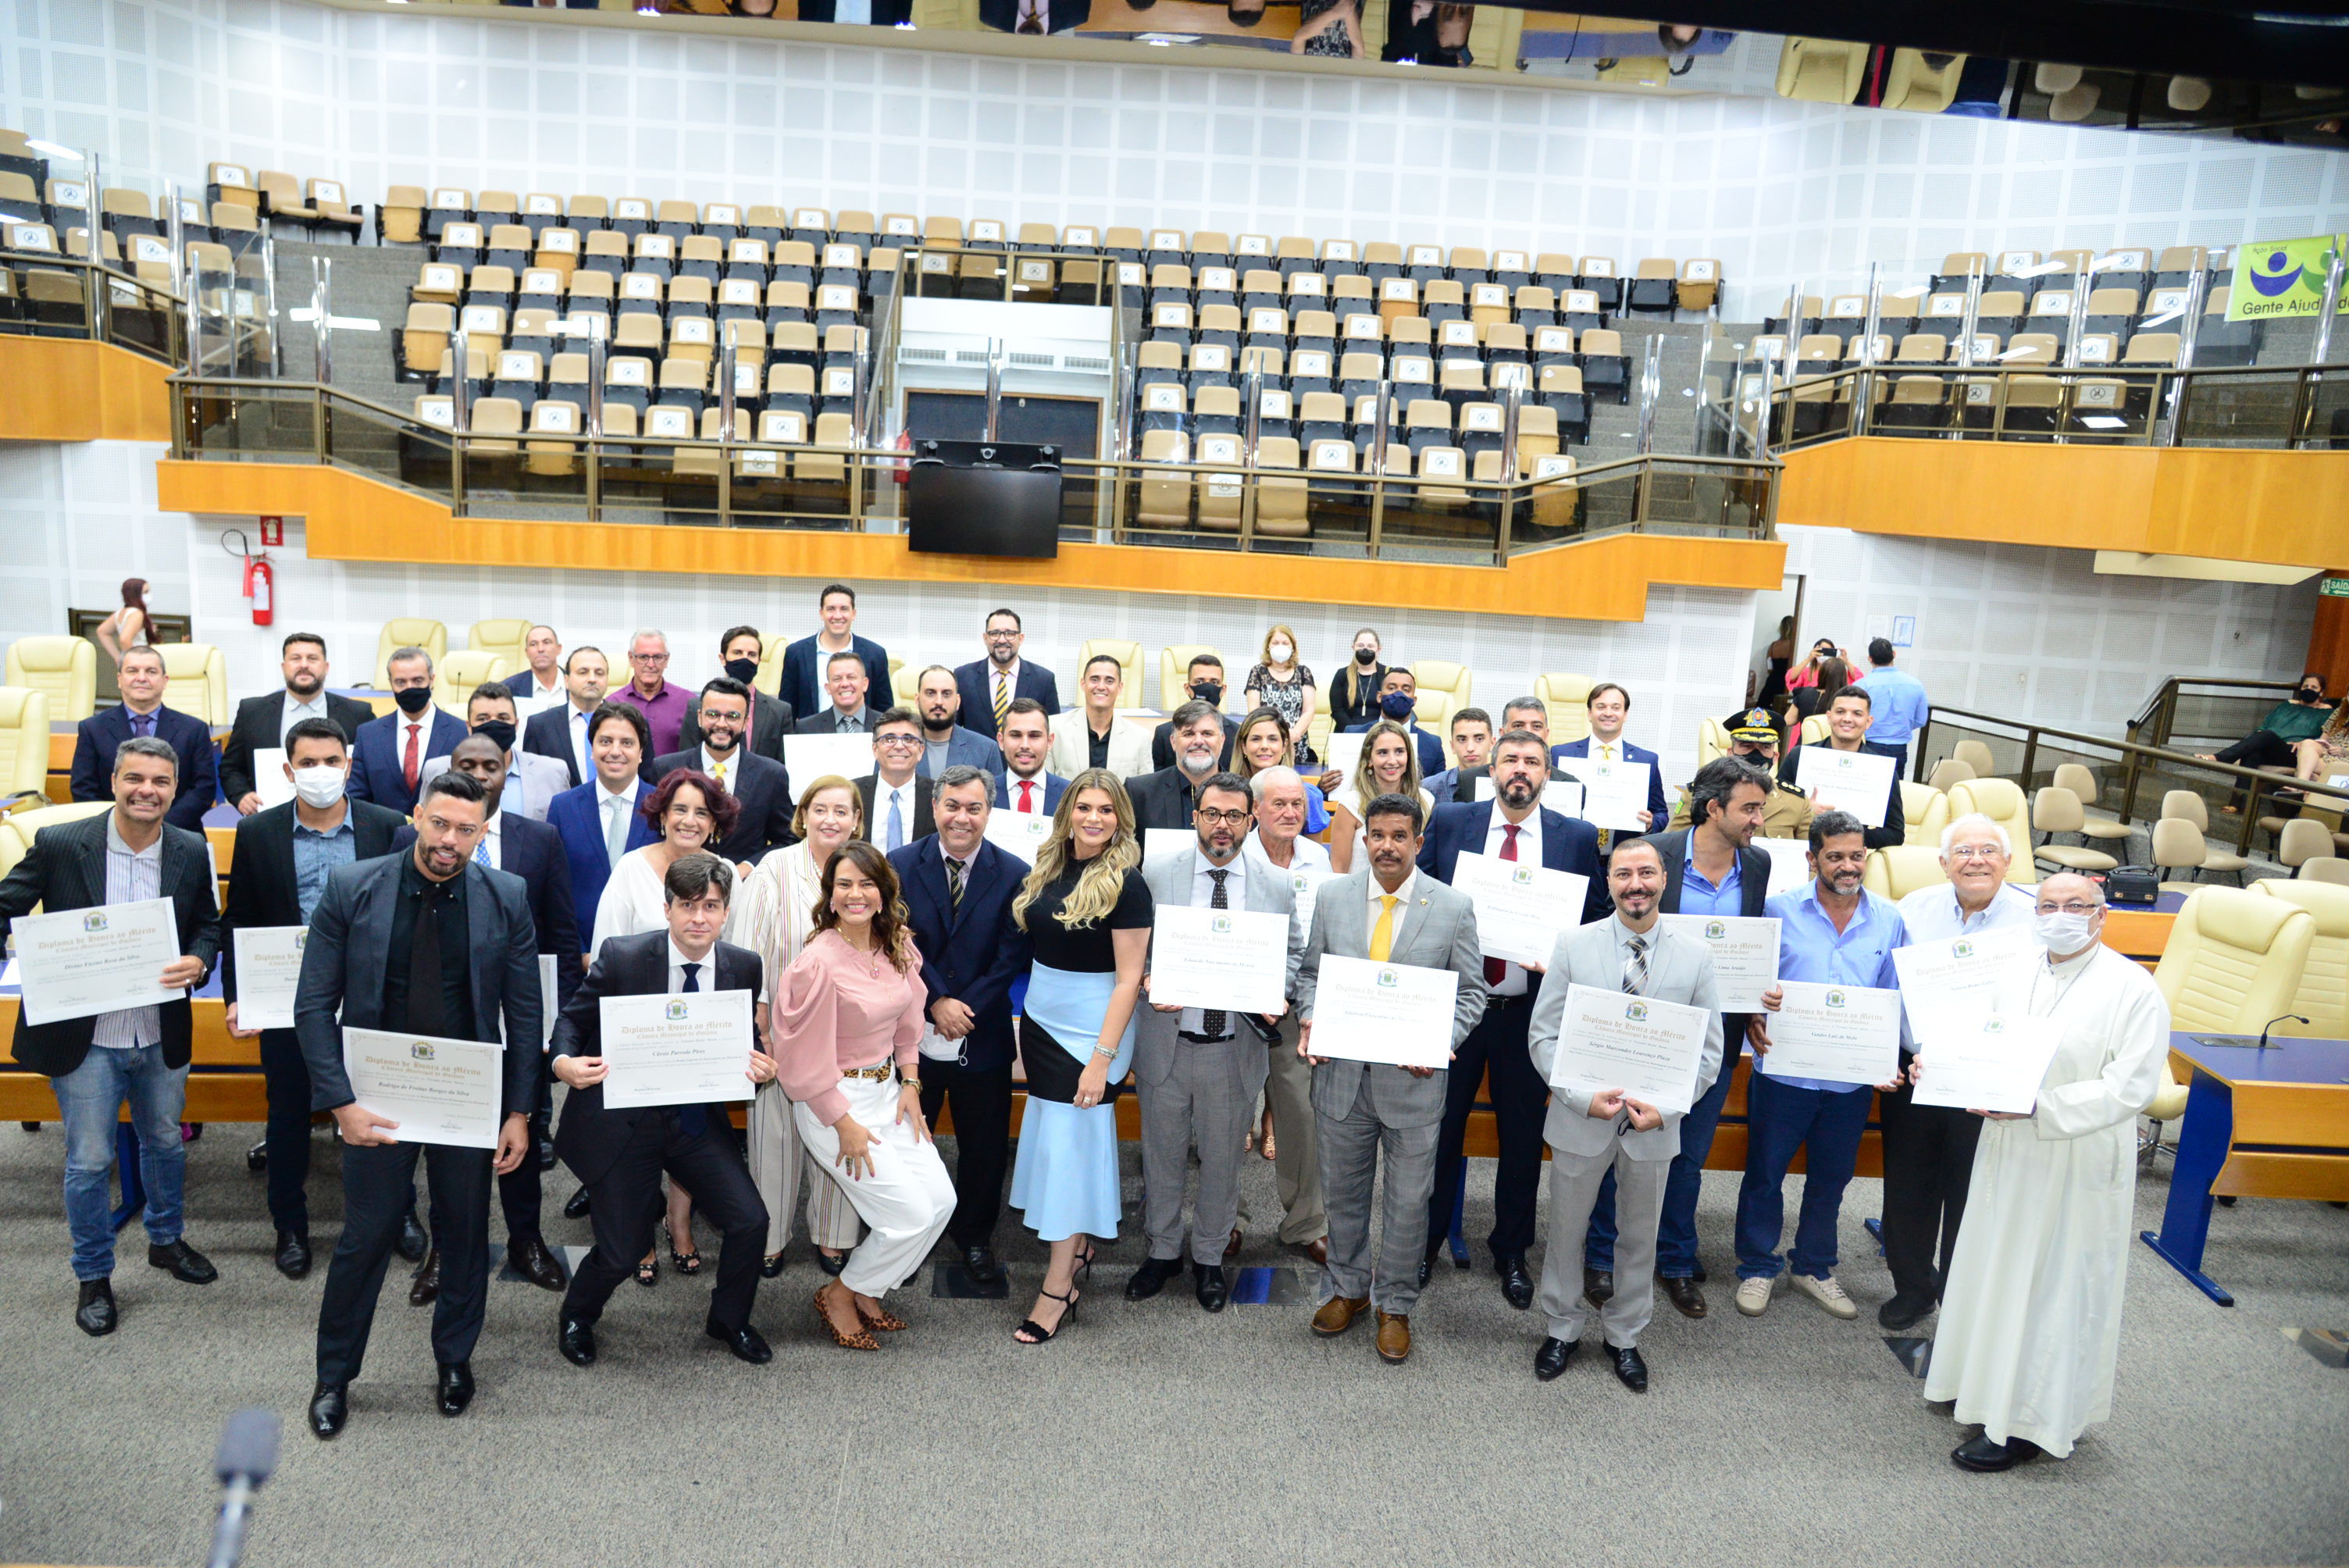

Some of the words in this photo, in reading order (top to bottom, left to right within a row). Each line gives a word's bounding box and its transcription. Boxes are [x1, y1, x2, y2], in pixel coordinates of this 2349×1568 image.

[2243, 302, 2283, 315] Gente
[2288, 297, 2349, 314] Ajudd
[621, 1026, 654, 1035] Diploma
[1582, 1014, 1613, 1027] Diploma
[1661, 1028, 1686, 1040] Mérito
[1588, 1041, 1604, 1049] Sérgio
[1606, 1043, 1631, 1054] Marcondes
[1632, 1047, 1656, 1059] Lourenço
[365, 1056, 400, 1067] Diploma
[454, 1065, 481, 1075] Mérito
[378, 1081, 400, 1089] Rodrigo
